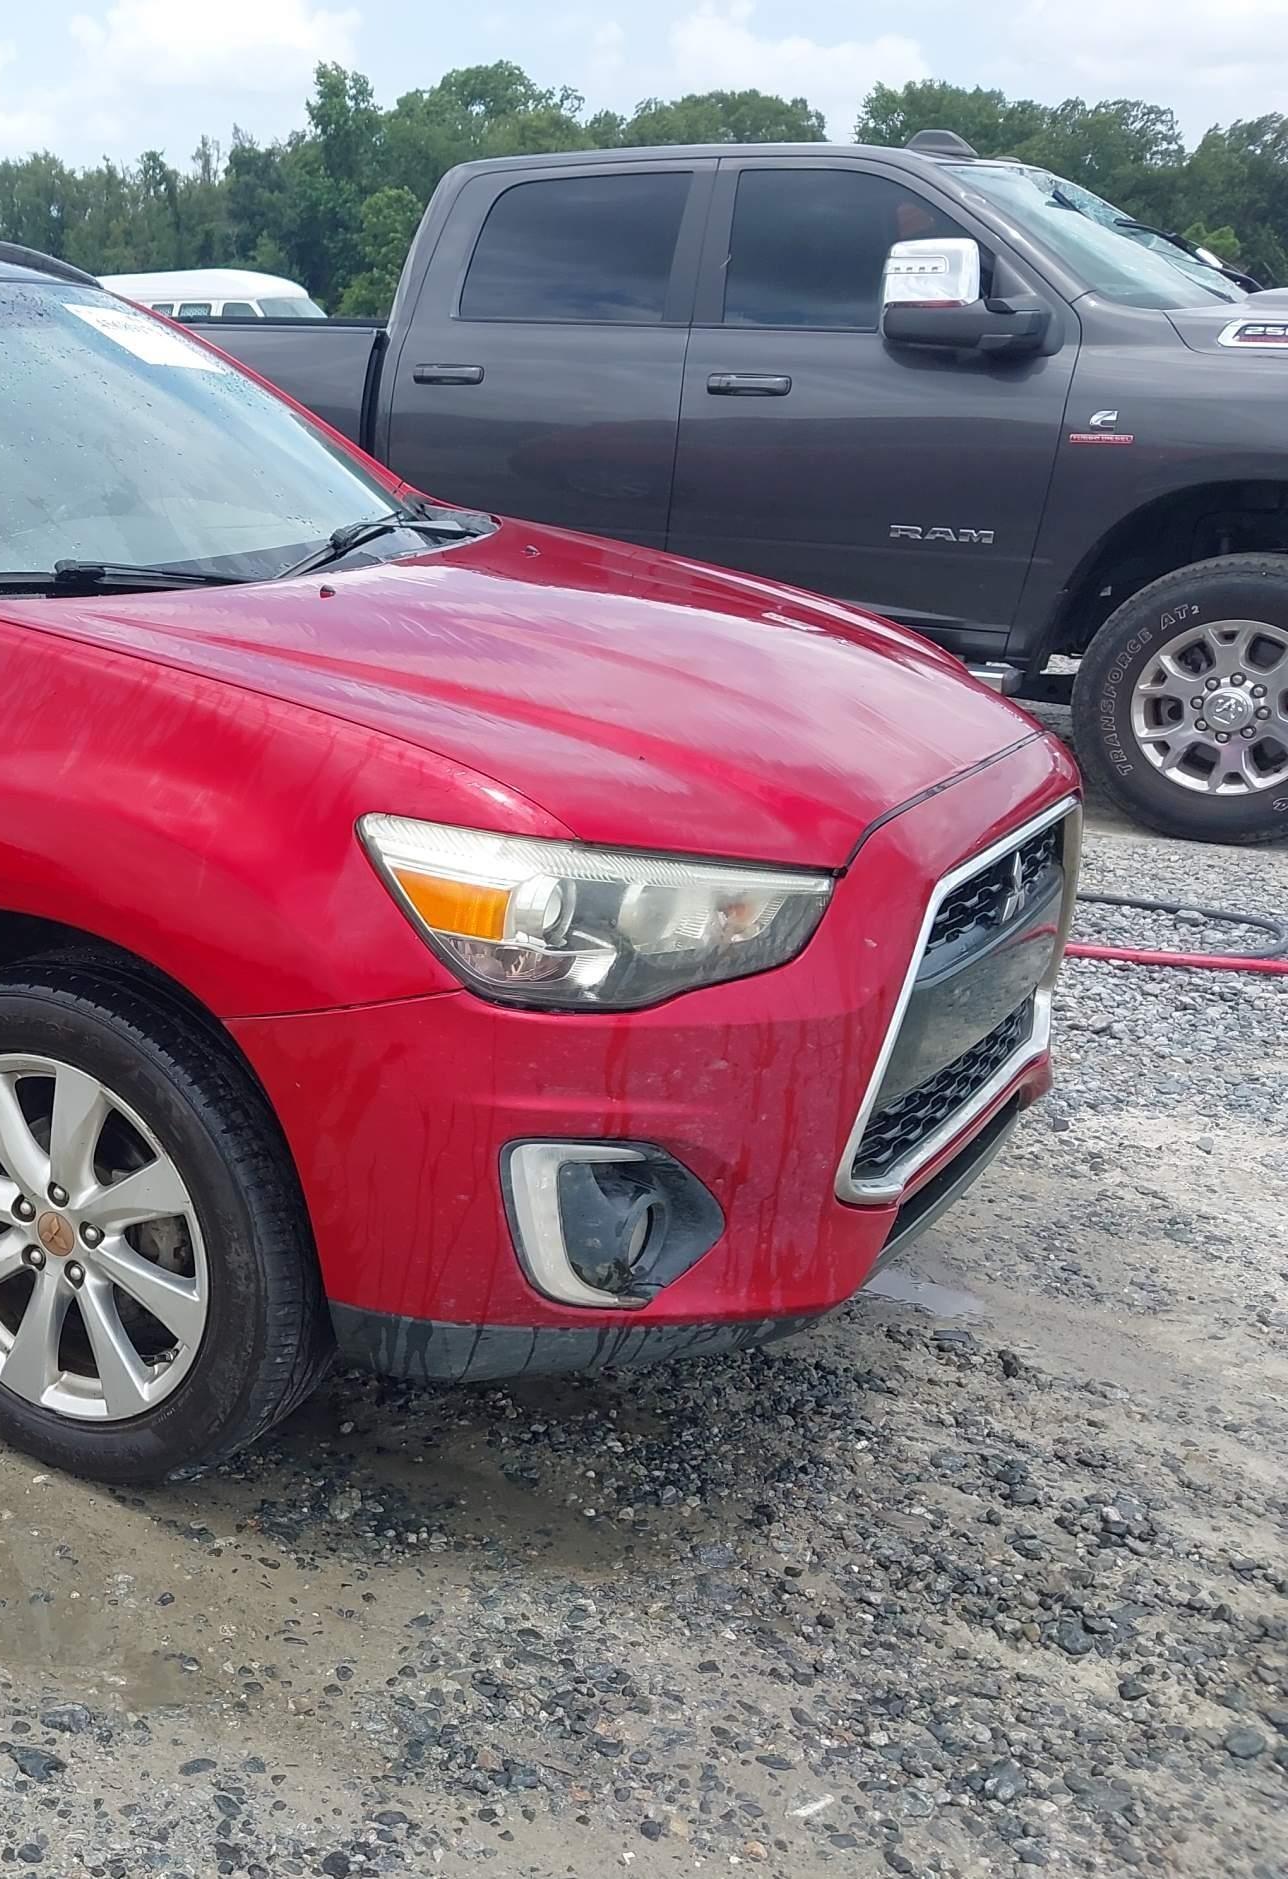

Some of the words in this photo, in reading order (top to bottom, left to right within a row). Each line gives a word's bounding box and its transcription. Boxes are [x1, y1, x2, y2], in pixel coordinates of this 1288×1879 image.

[1244, 326, 1288, 336] 25
[890, 525, 994, 544] RAM
[1100, 628, 1153, 776] TRANSFORCE
